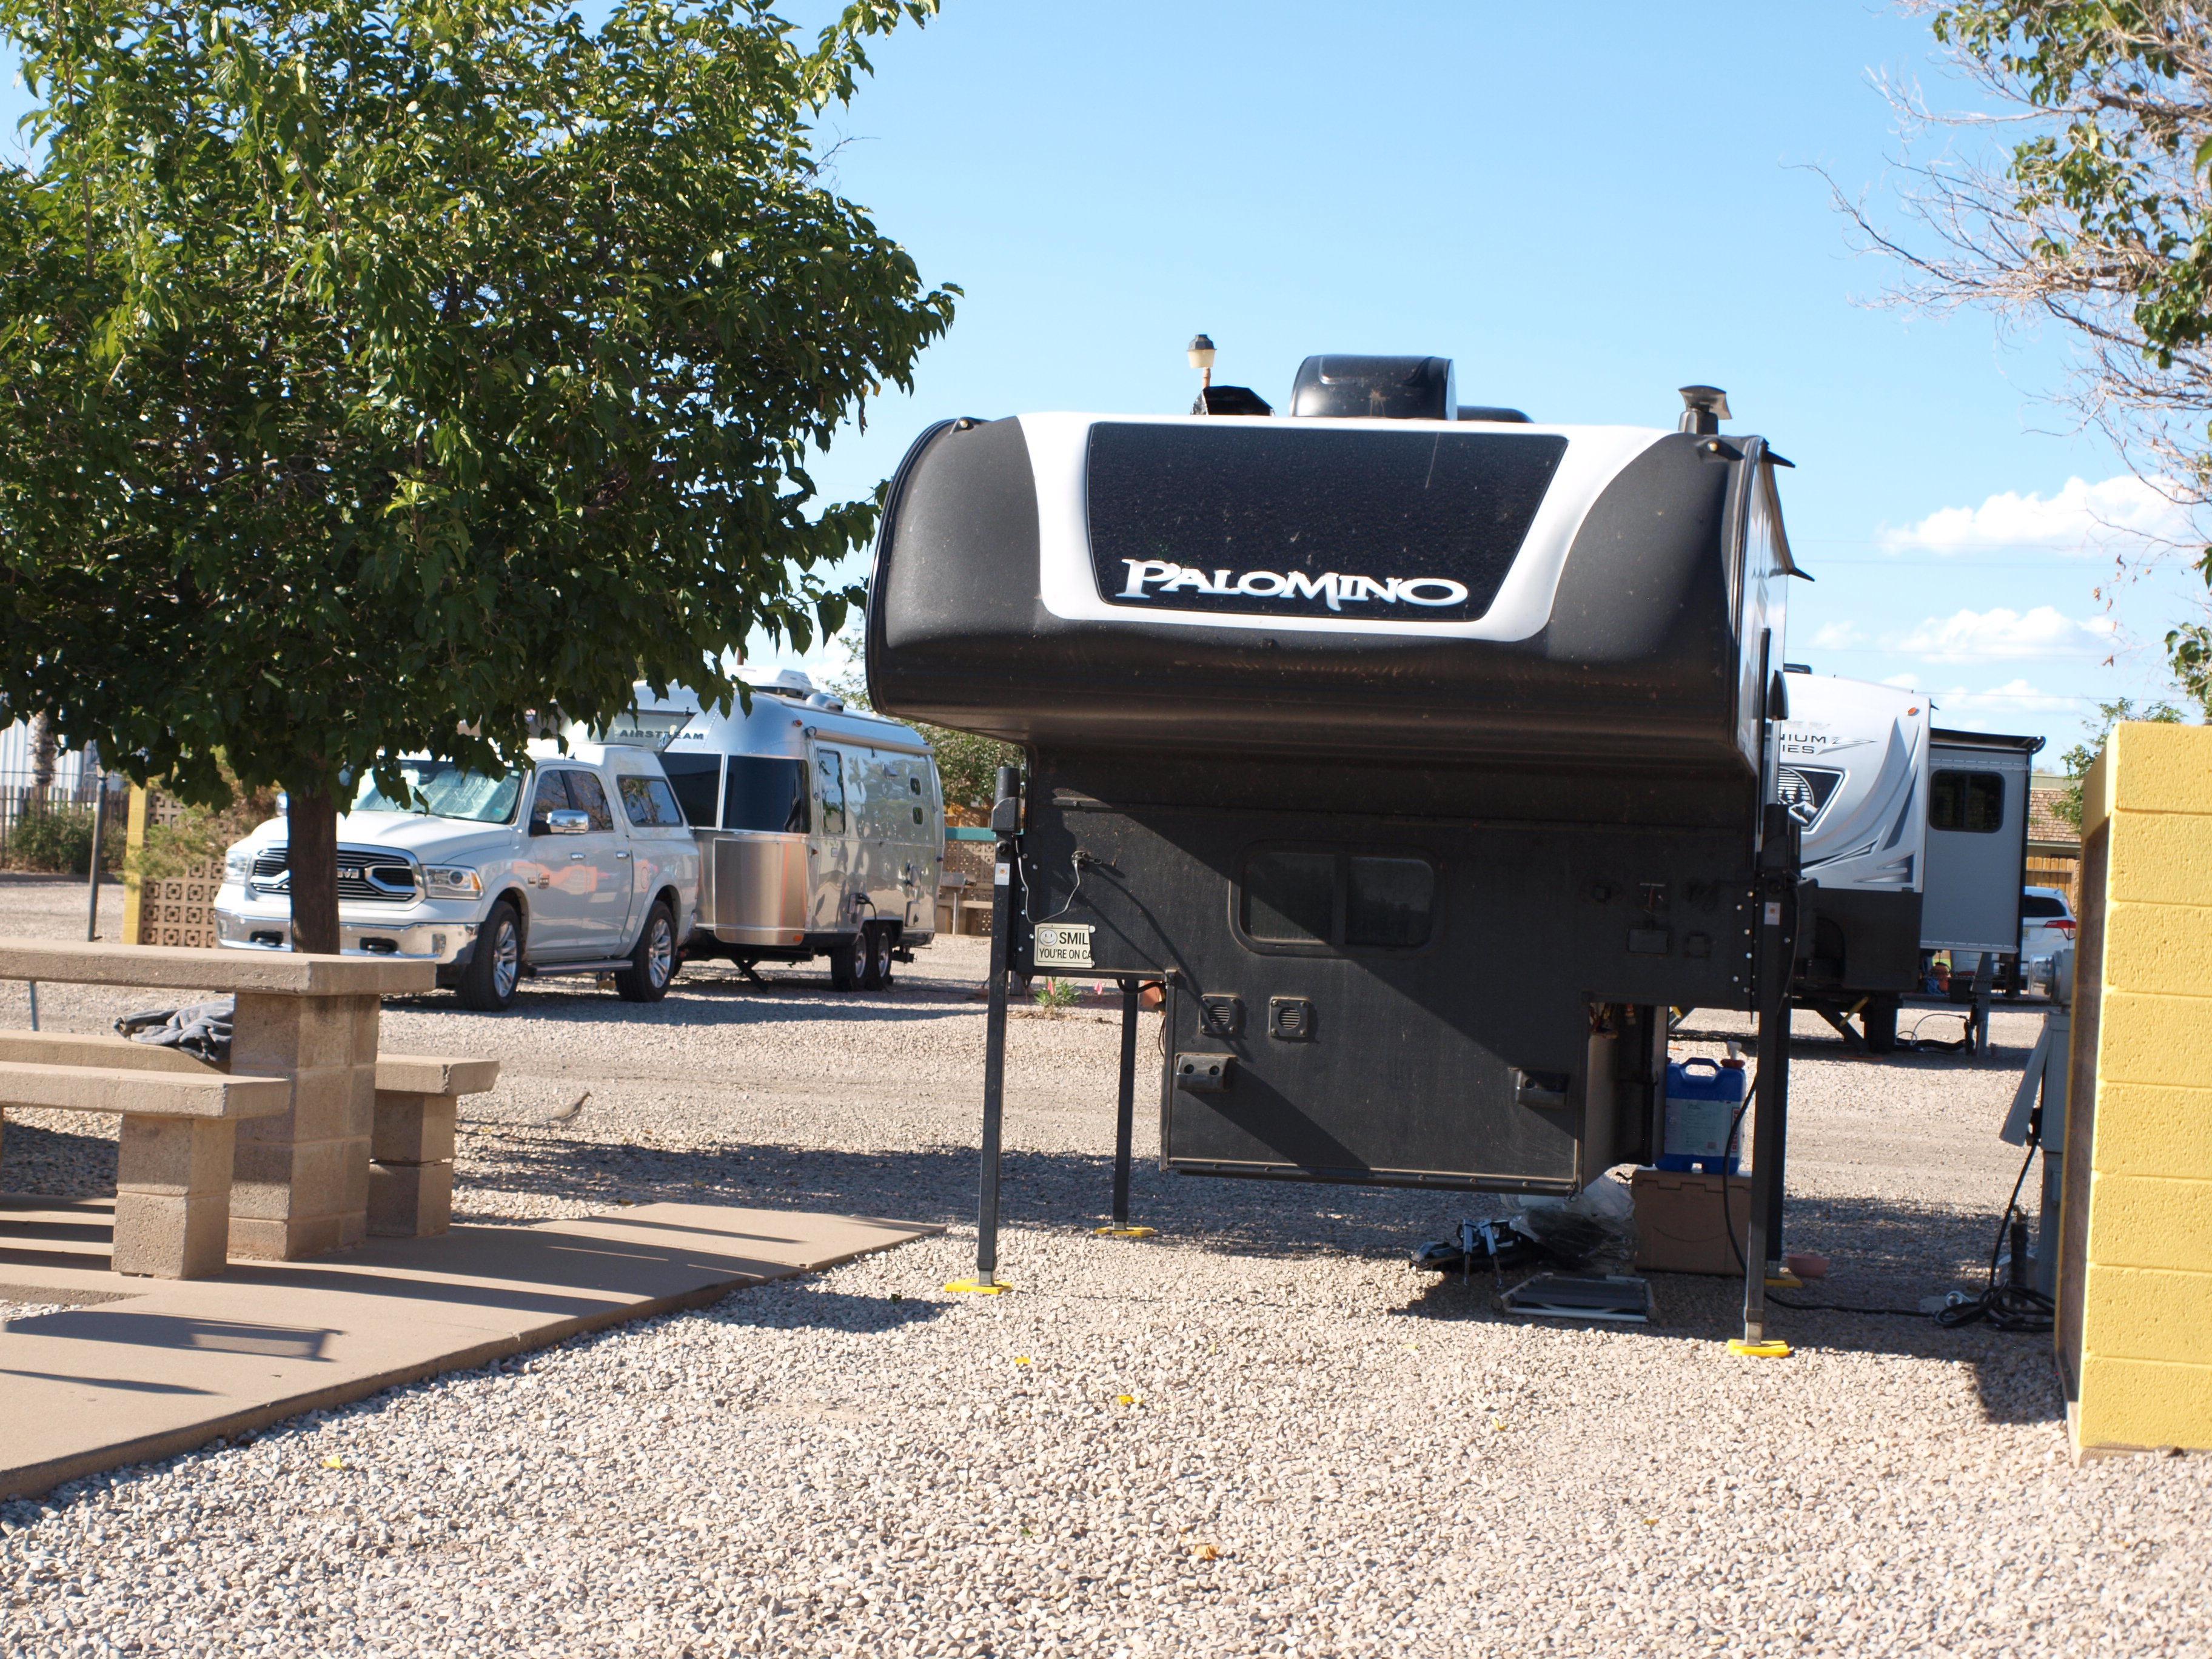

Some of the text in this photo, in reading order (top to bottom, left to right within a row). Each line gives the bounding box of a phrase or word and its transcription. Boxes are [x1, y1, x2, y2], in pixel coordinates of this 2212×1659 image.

[1116, 558, 1469, 612] PALOMINO
[1059, 932, 1089, 945] SMIL
[1039, 948, 1067, 959] YOU'RE
[1068, 949, 1081, 959] ON
